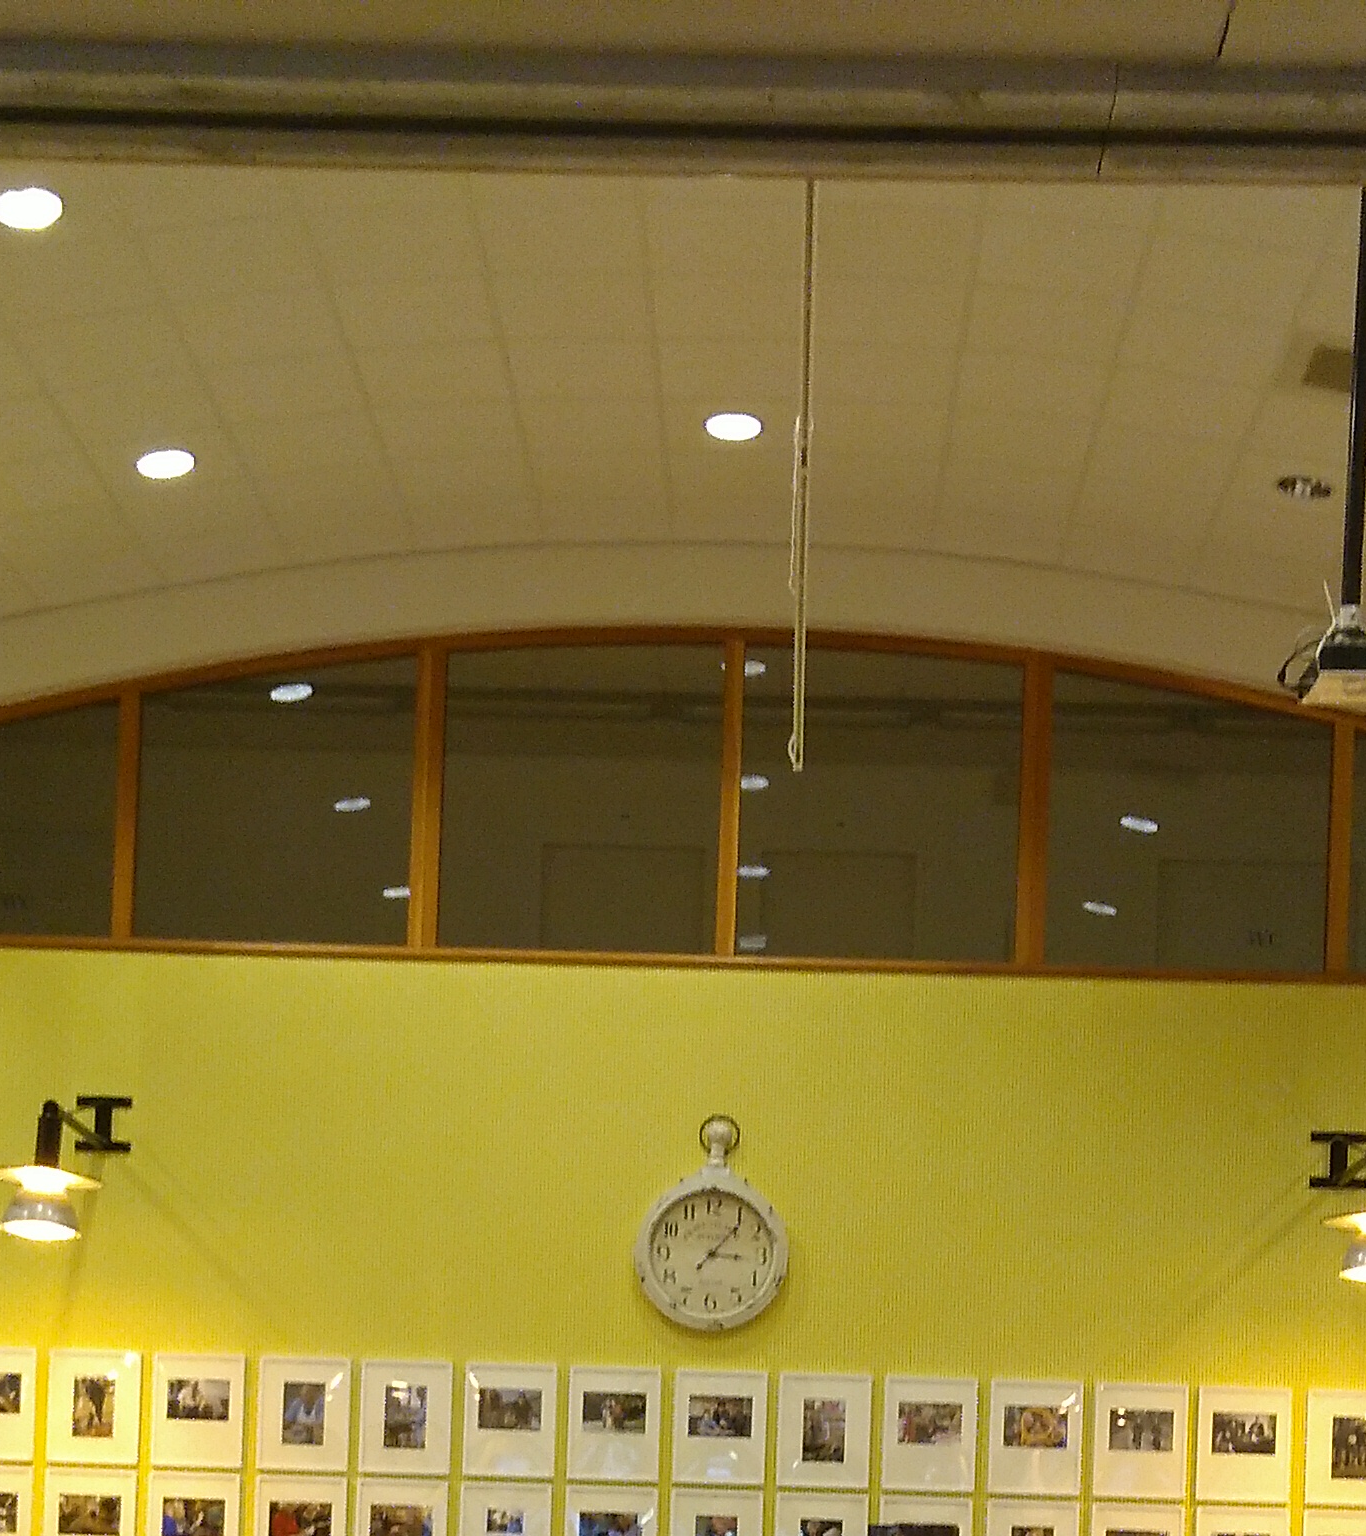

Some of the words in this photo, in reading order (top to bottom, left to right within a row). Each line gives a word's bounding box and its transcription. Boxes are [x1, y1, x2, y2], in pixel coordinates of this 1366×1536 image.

[683, 1204, 695, 1220] 11
[664, 1222, 679, 1238] 10
[704, 1293, 717, 1310] 6
